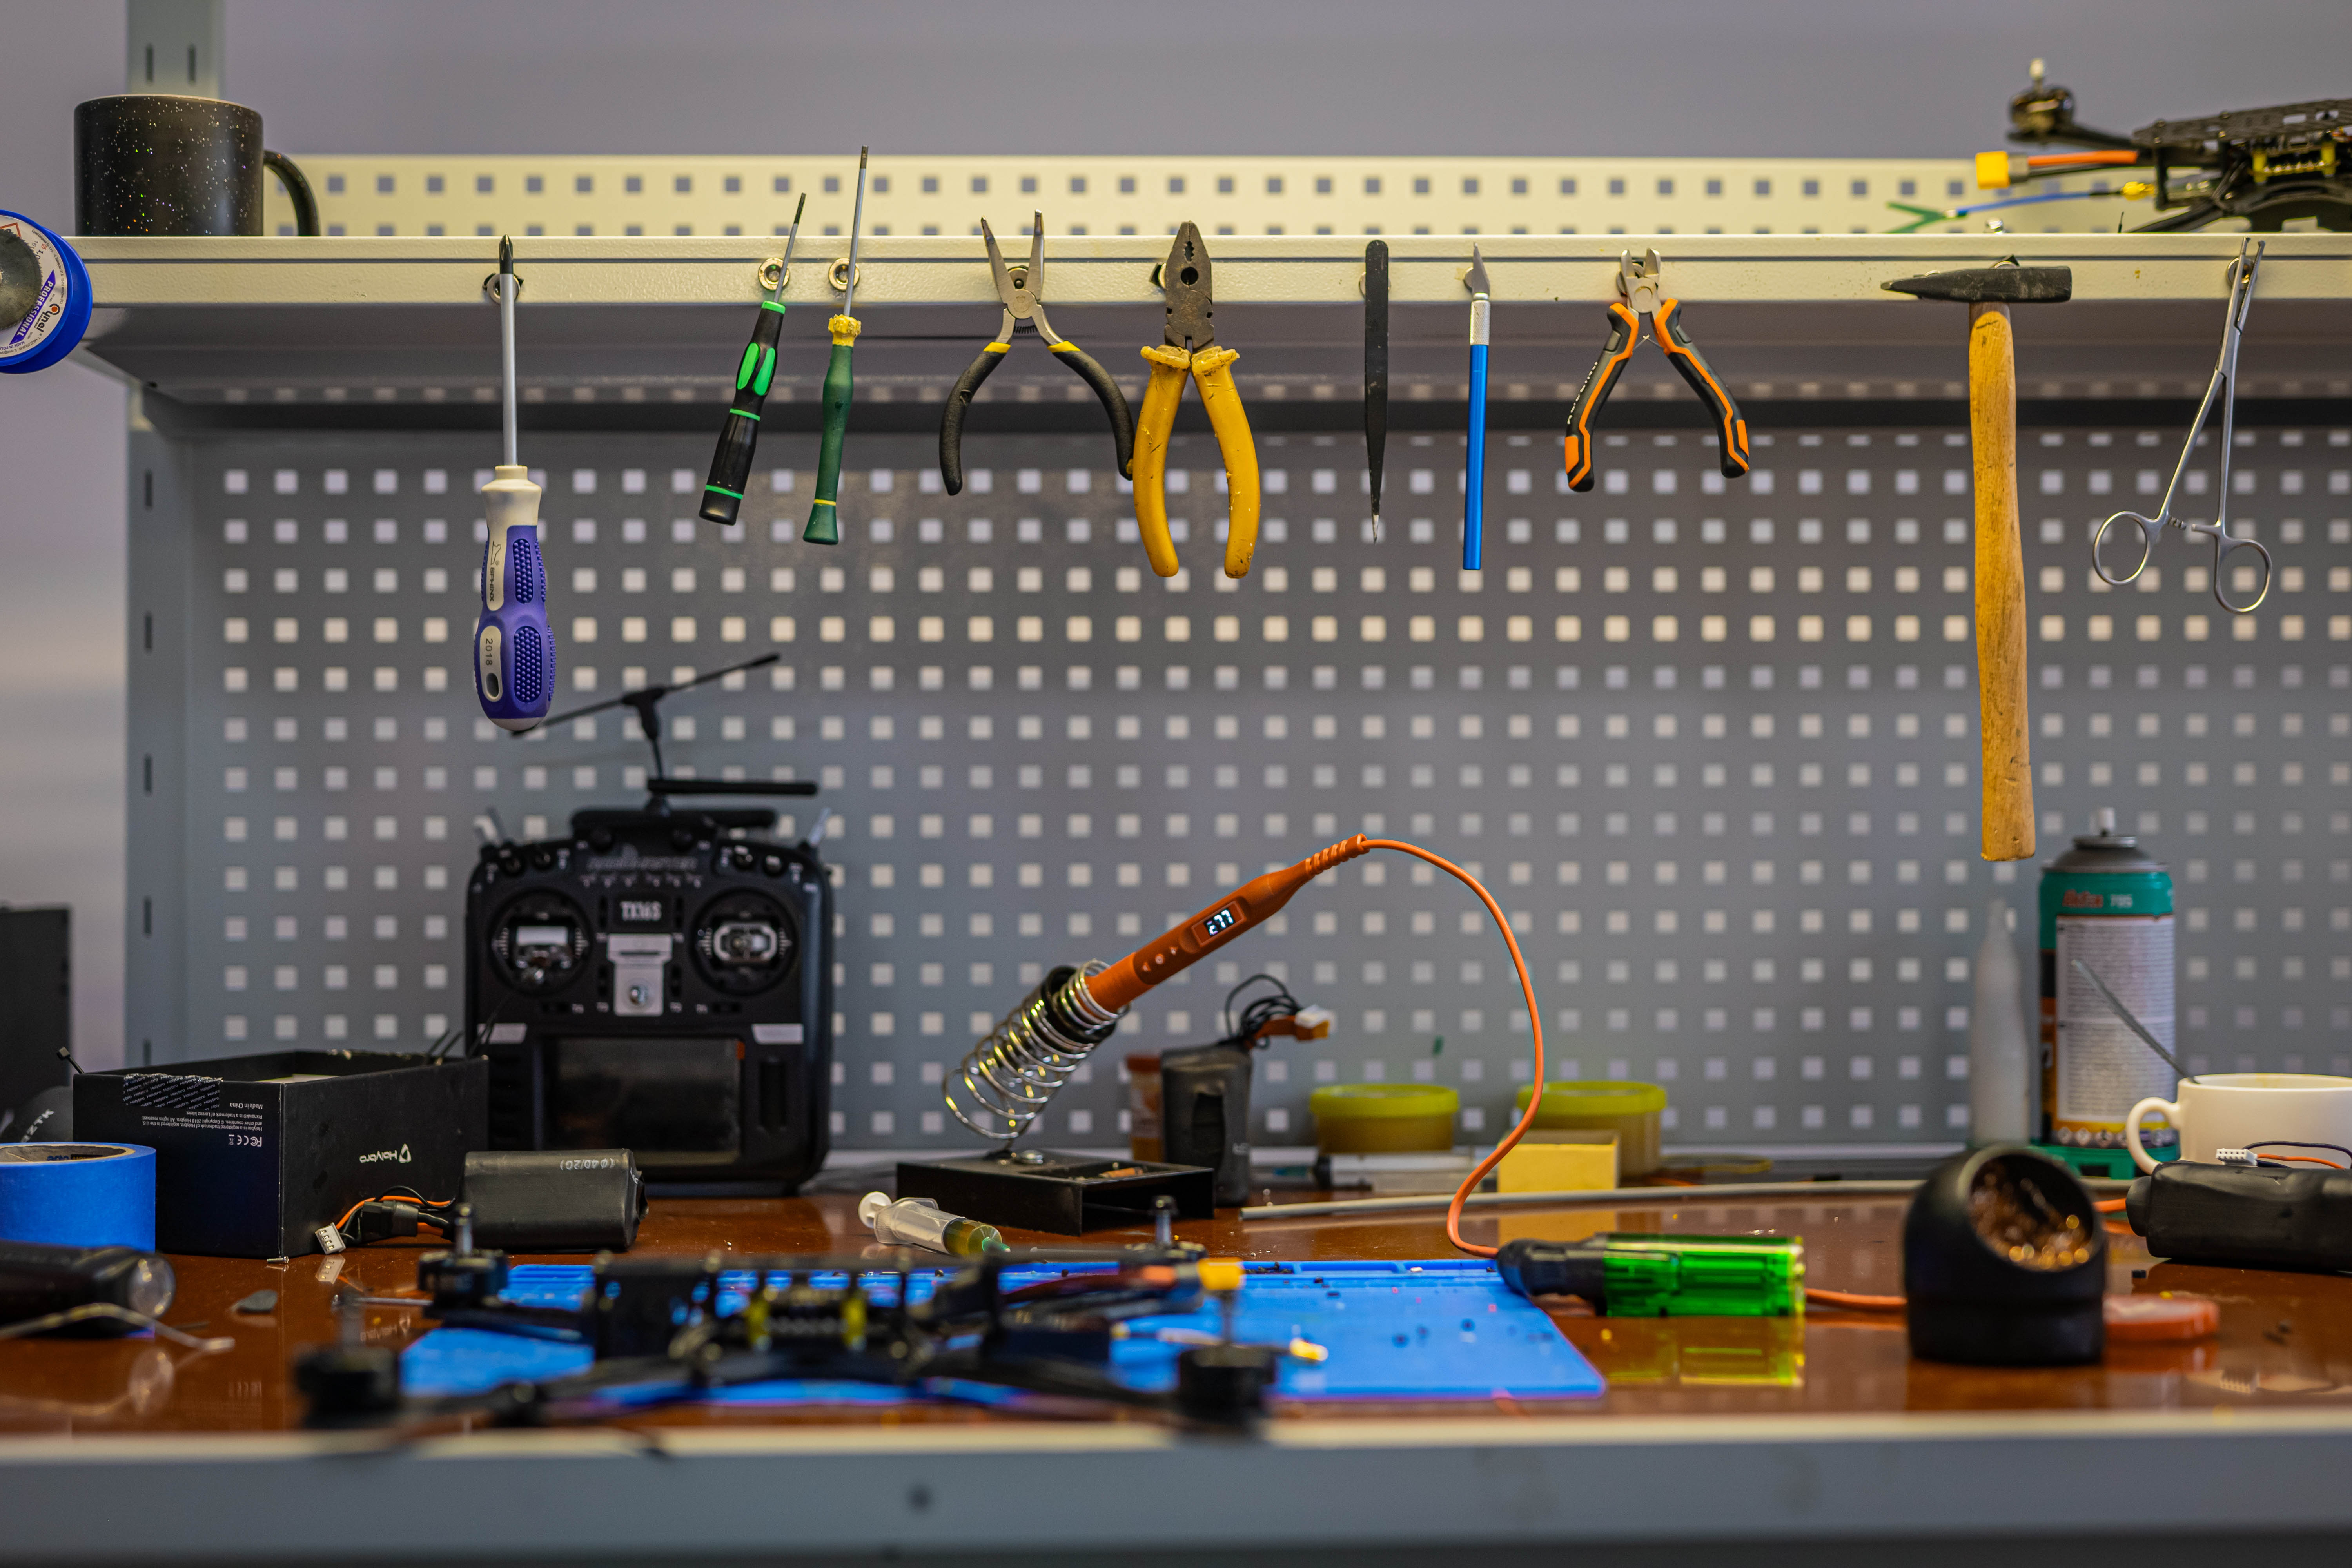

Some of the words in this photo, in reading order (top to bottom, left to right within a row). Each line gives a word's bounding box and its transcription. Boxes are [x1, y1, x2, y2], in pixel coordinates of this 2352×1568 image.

[17, 280, 53, 336] PROFESSIONAL
[37, 304, 60, 332] Cynel
[1207, 909, 1234, 936] 277
[359, 1150, 397, 1163] Holybro
